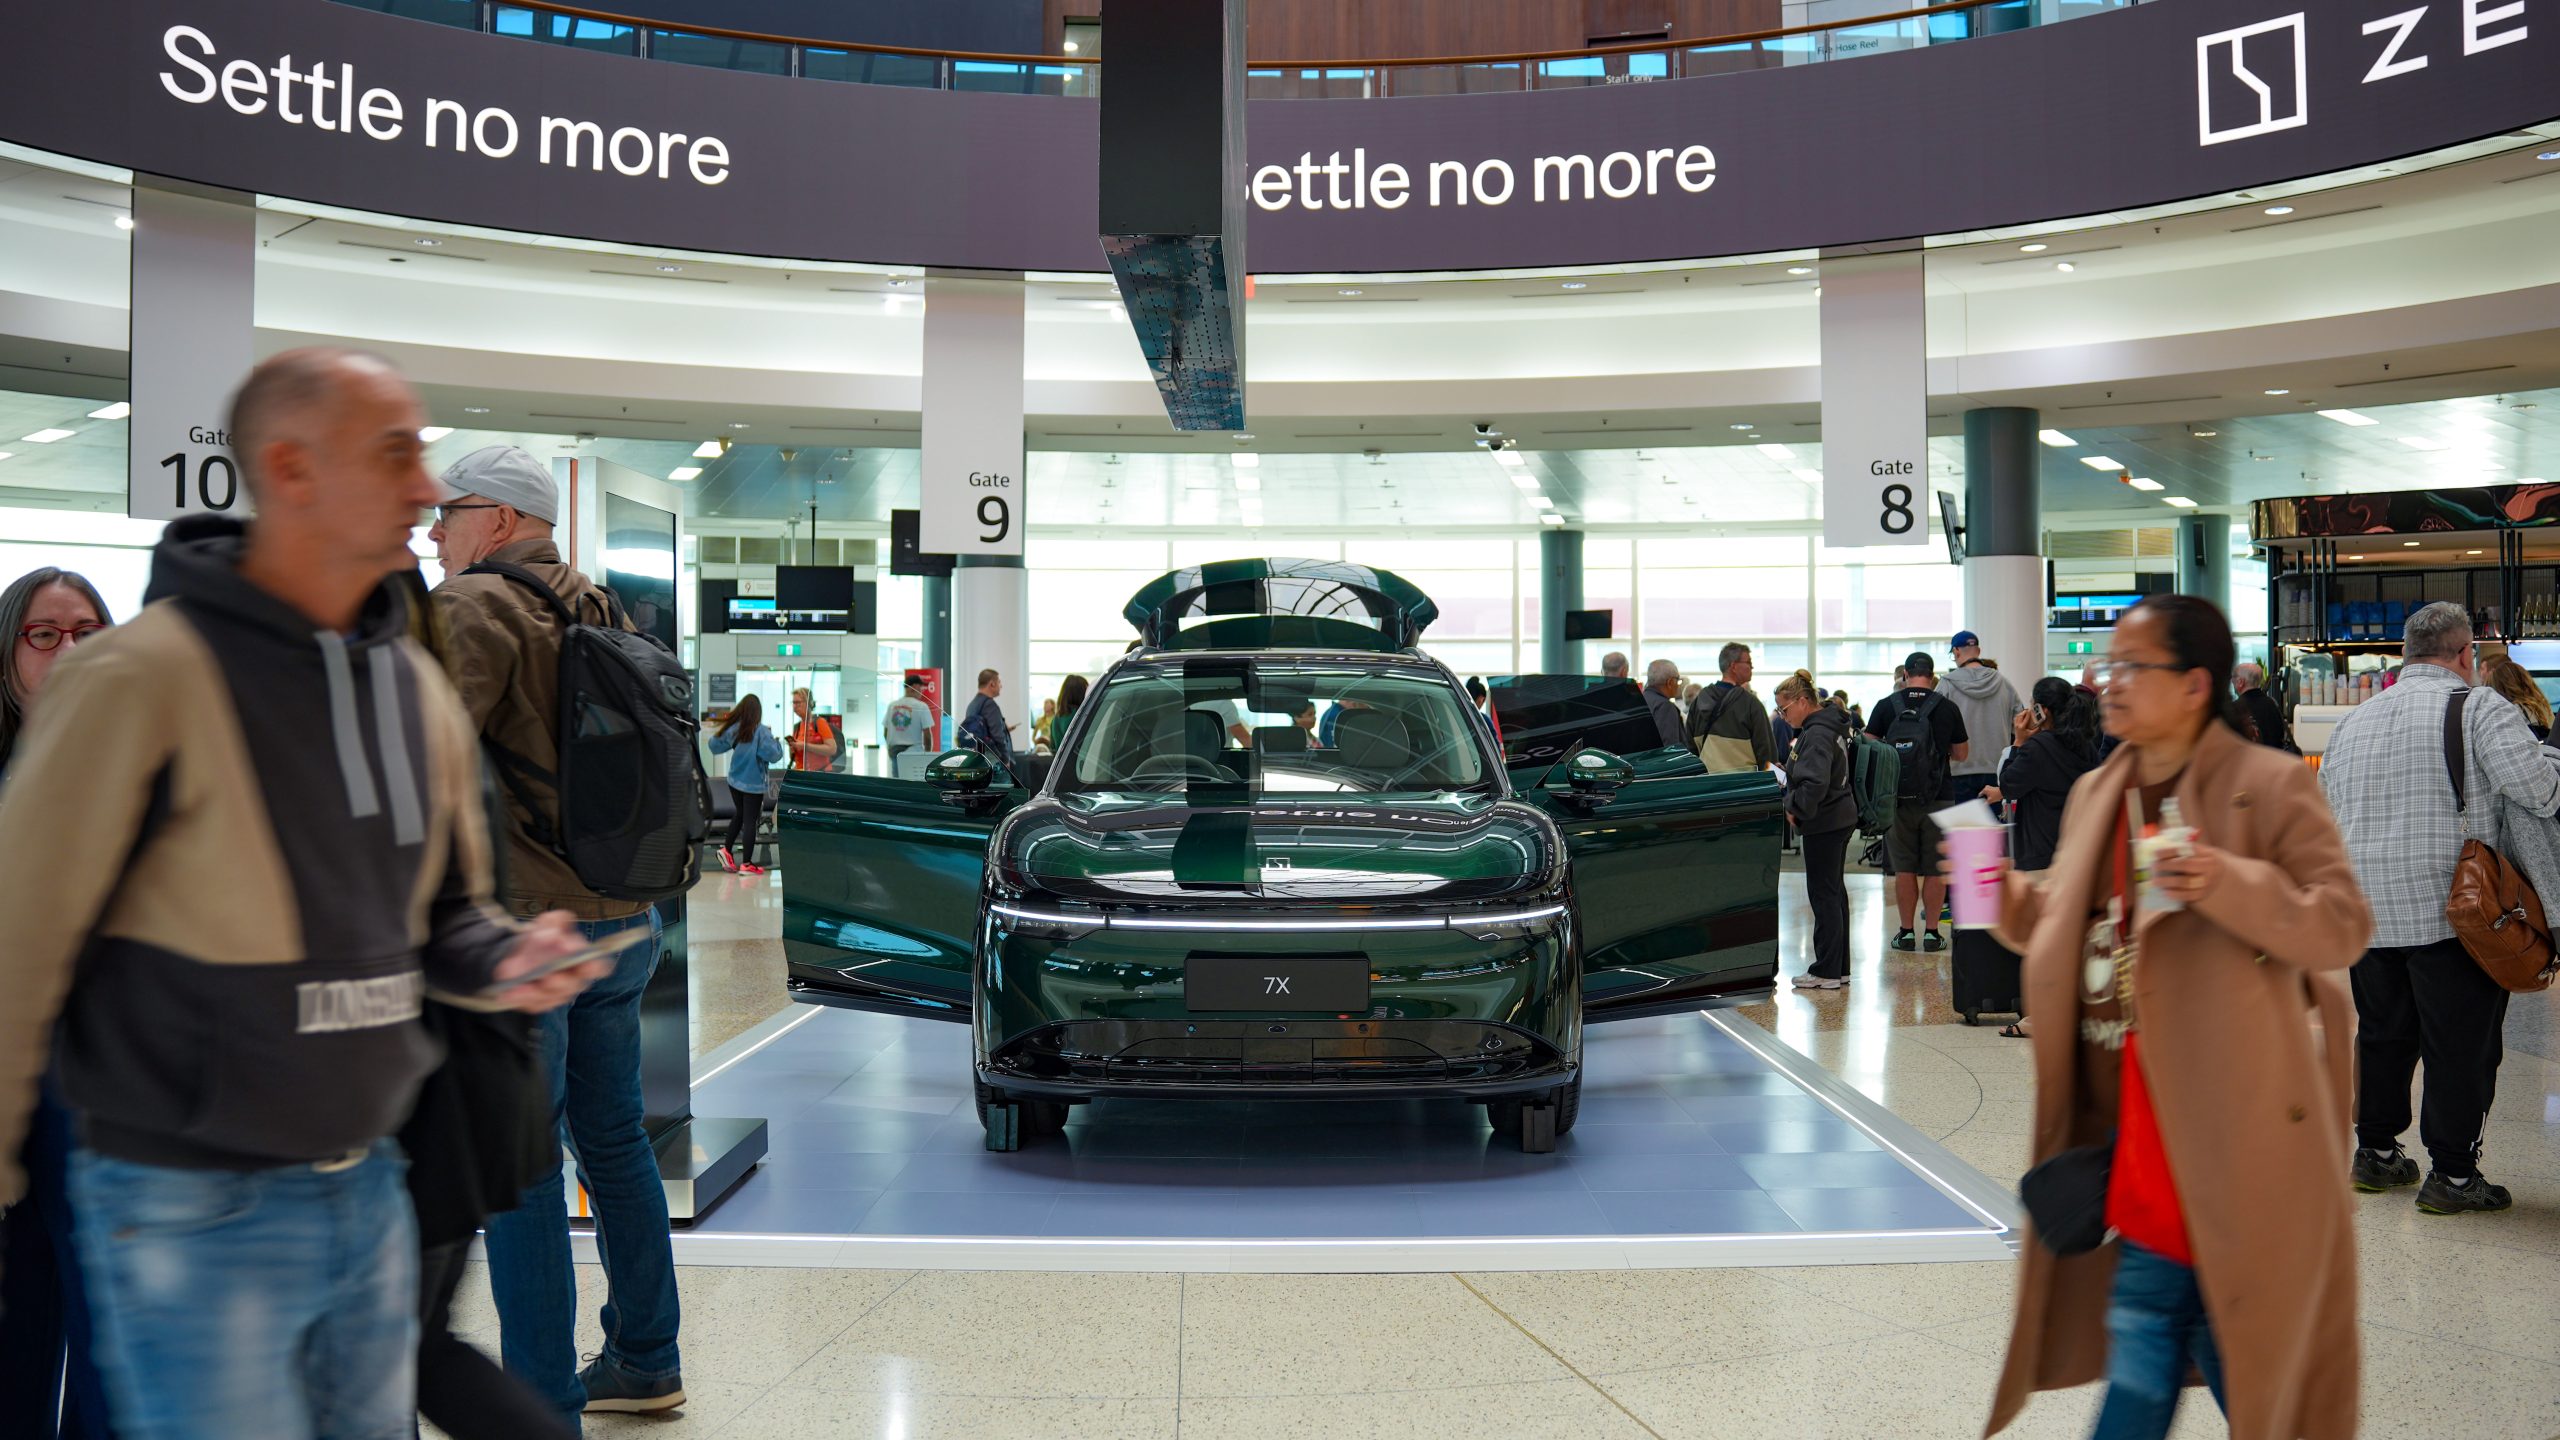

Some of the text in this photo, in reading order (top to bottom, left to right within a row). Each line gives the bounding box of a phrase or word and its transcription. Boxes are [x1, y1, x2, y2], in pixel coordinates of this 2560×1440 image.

[1860, 39, 1878, 49] Reel
[1605, 75, 1630, 84] Staff
[159, 25, 730, 186] Settle no more
[1247, 144, 1716, 211] ettle no more
[189, 426, 234, 447] Gate
[1870, 460, 1913, 476] Gate
[160, 452, 237, 512] 10
[969, 473, 1010, 488] Gate
[976, 495, 1010, 544] 9
[1880, 483, 1915, 535] 8
[1263, 976, 1291, 995] 7X
